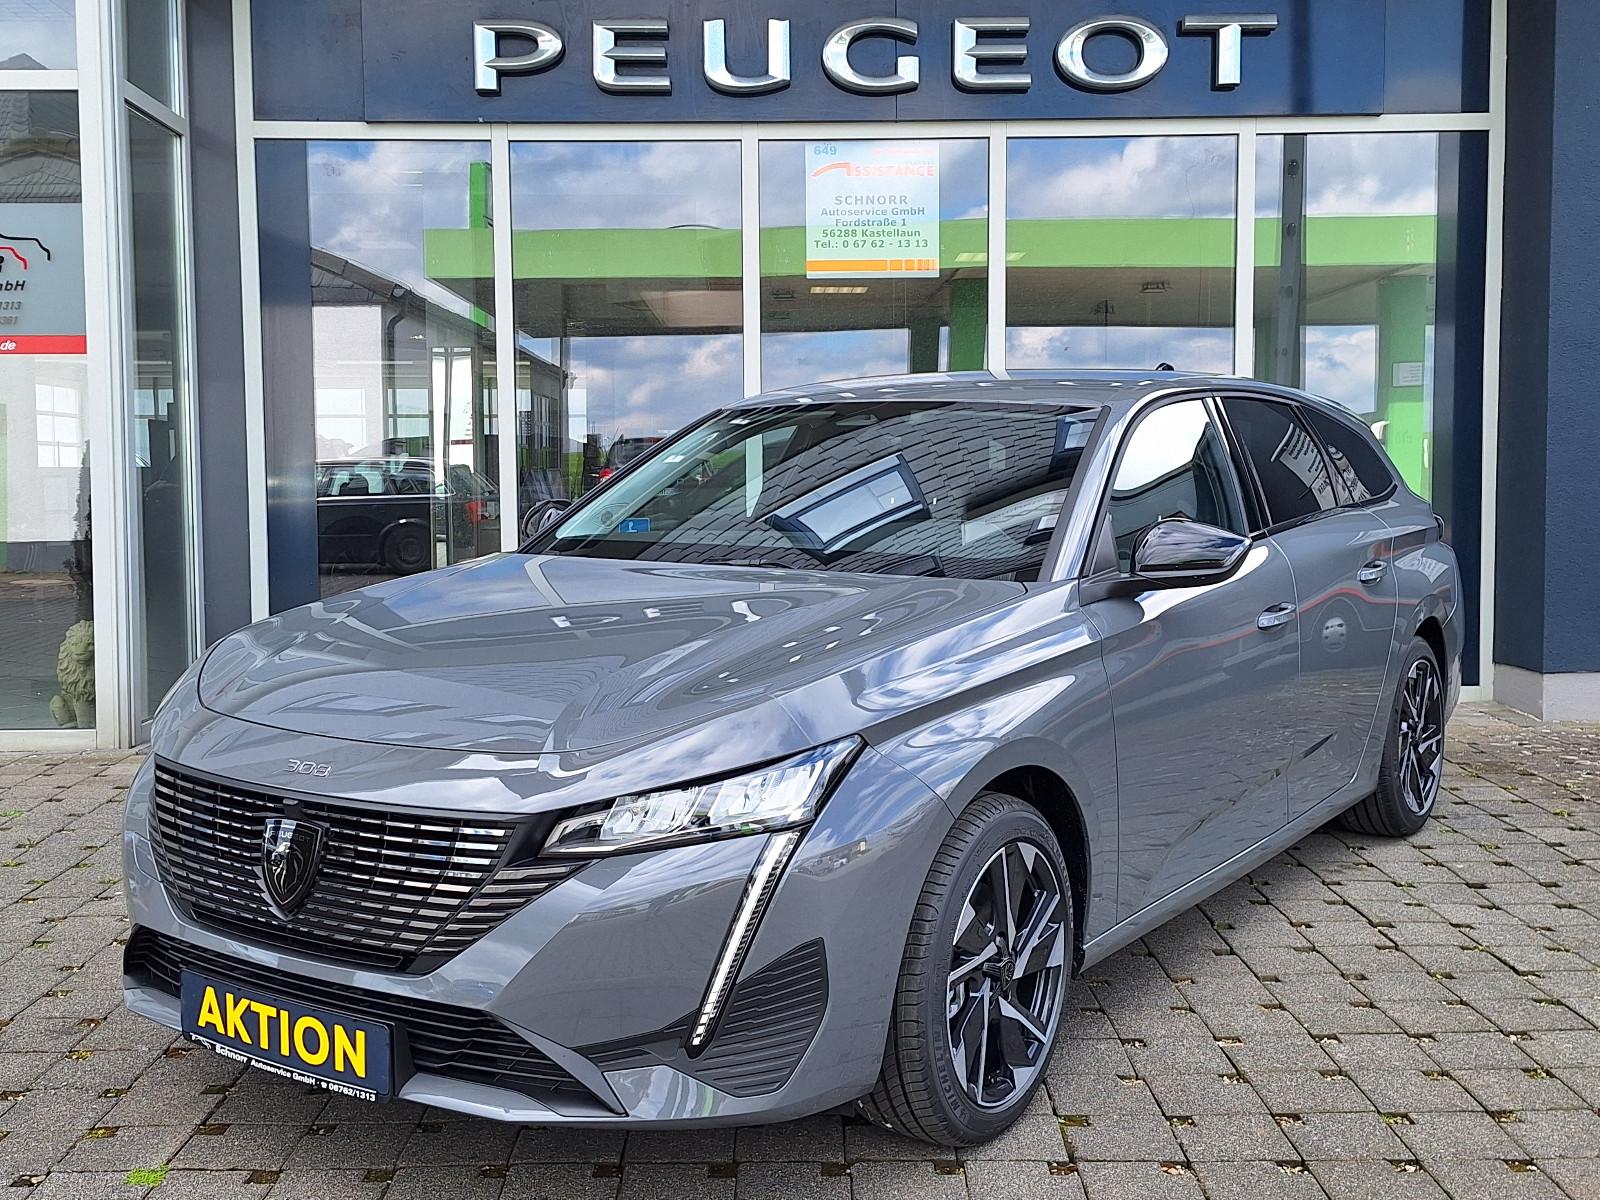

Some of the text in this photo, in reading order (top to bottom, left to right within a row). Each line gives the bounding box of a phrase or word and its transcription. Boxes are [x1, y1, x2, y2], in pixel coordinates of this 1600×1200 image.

[473, 14, 1279, 94] PEUGEOT
[813, 145, 838, 156] 649
[834, 195, 909, 205] SCHNORR
[820, 207, 925, 217] Autoservice GmbH
[835, 218, 906, 227] Fordstraße 1
[822, 228, 921, 238] 56288 Kastellaun
[814, 240, 839, 249] Tel.:
[842, 240, 849, 249] 0
[853, 240, 866, 249] 67
[871, 240, 885, 249] 62
[897, 239, 910, 248] 13
[915, 239, 929, 248] 13
[287, 758, 332, 778] 308
[269, 830, 311, 843] PEUGEOT
[197, 985, 366, 1079] AKTION
[215, 1043, 376, 1103] Schnorr Autoservice GmbH 06762/1313
